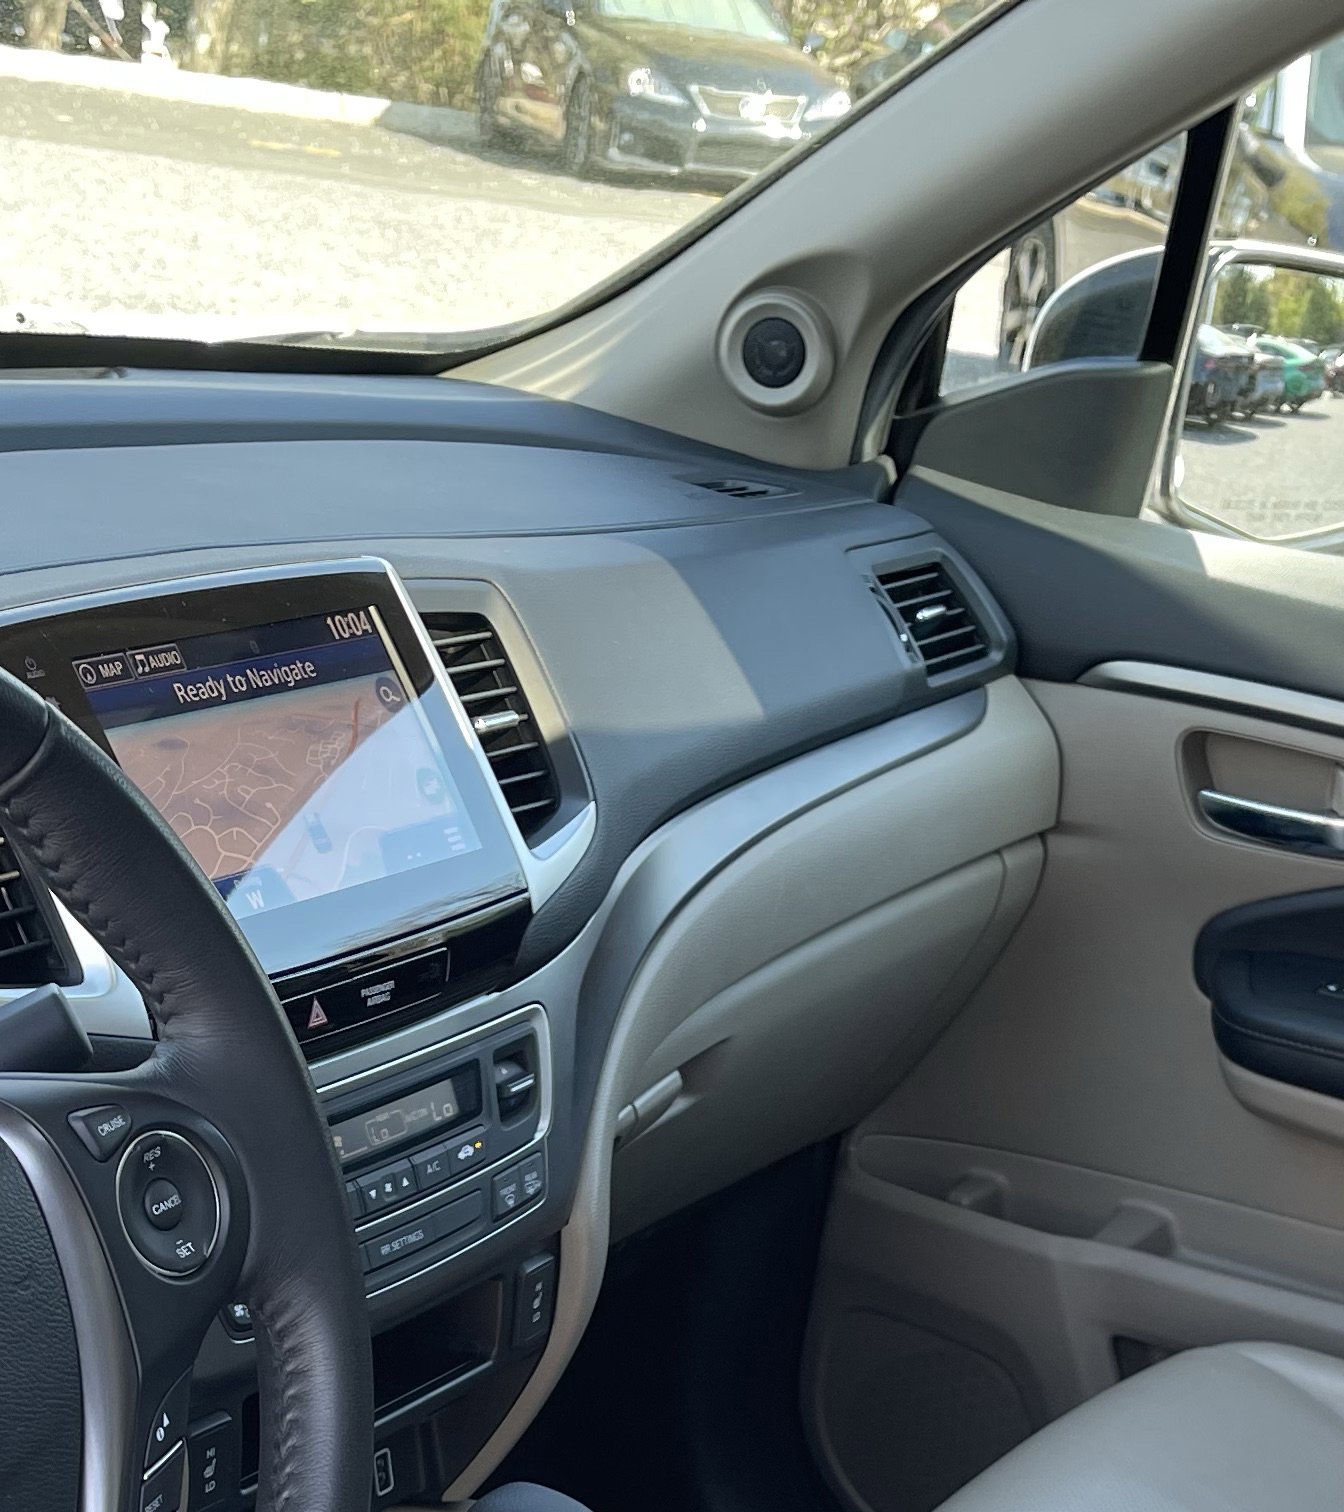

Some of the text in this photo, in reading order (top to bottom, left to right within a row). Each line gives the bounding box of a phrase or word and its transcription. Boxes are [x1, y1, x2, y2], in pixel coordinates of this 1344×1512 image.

[326, 610, 373, 640] 10:04
[98, 660, 123, 678] MAP
[149, 650, 181, 670] AUDIO
[172, 659, 318, 704] Ready to Navigate
[97, 1114, 126, 1137] CRUISE
[143, 1146, 161, 1163] RES
[426, 1160, 441, 1174] A/C
[152, 1194, 181, 1215] CANCEL
[176, 1242, 195, 1259] SET
